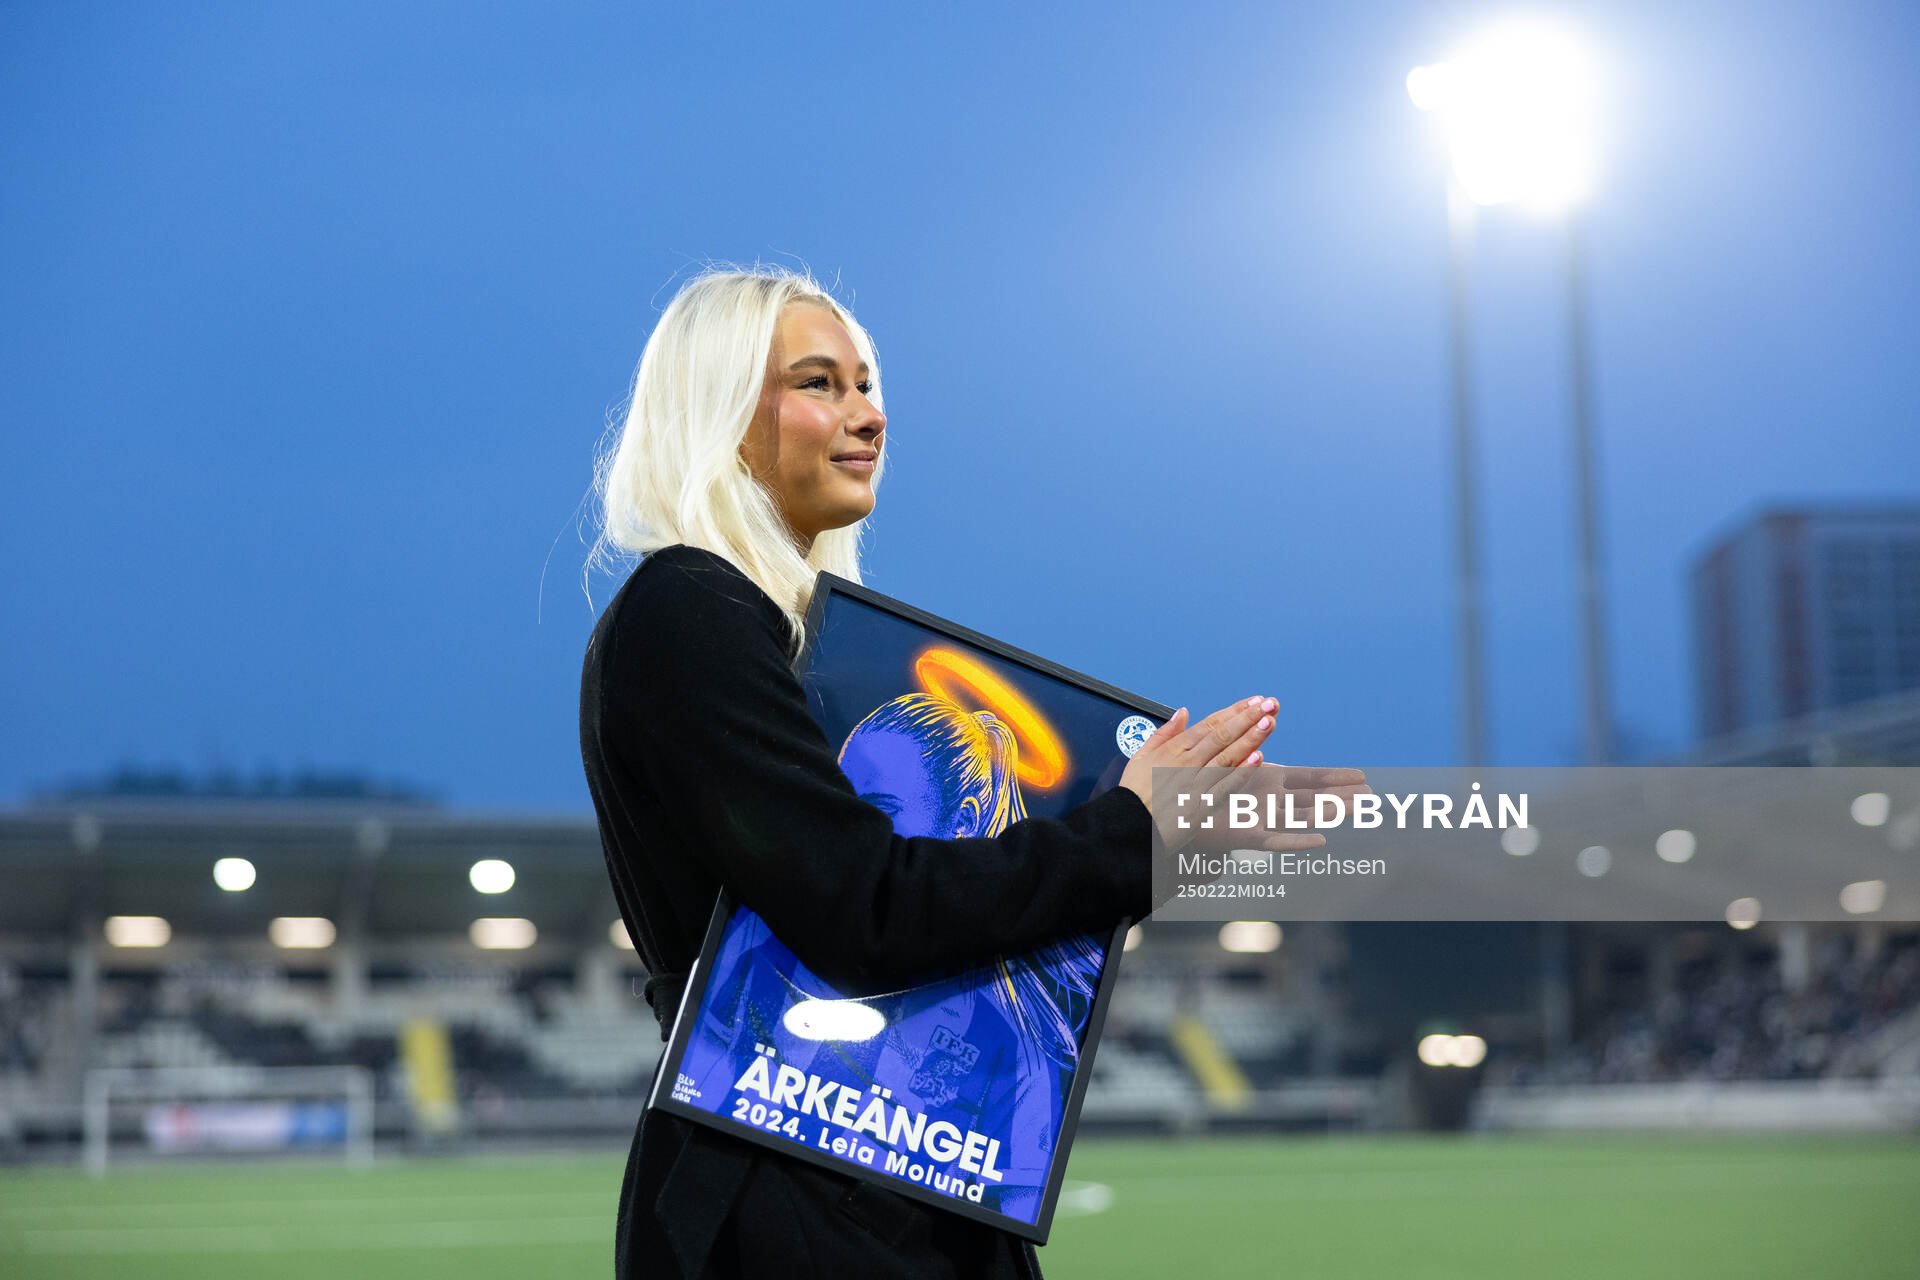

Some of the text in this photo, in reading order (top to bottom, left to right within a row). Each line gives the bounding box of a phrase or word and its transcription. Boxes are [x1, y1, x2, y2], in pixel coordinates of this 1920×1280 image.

[677, 1073, 695, 1086] BLU
[734, 1043, 1004, 1182] ÄRKEÄNGEL
[733, 1098, 986, 1203] 2024. Leia Molund
